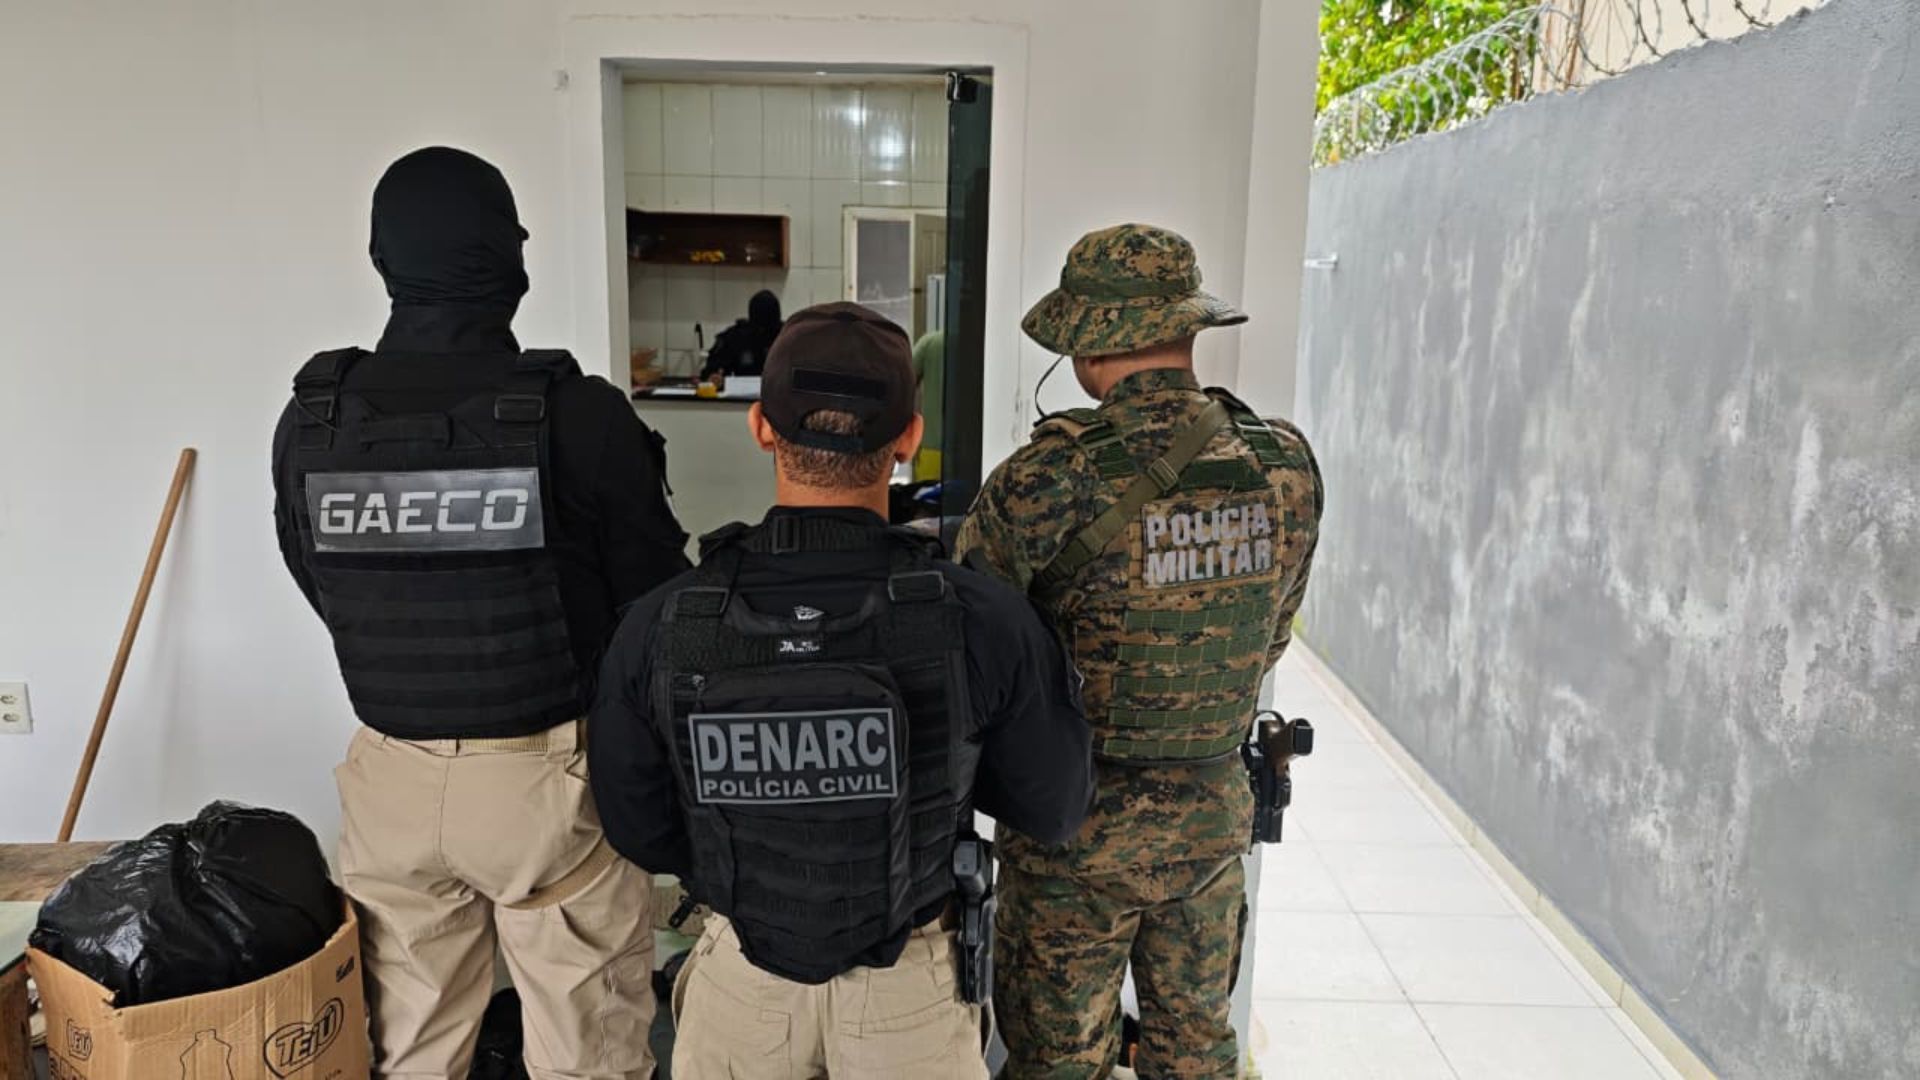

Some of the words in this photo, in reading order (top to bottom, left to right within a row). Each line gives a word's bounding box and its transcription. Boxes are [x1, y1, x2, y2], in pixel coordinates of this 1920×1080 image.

[319, 489, 529, 534] GAECO
[1146, 538, 1273, 588] MILITAR
[697, 716, 888, 773] DENARC
[702, 776, 811, 798] POLÍCIA
[818, 773, 890, 796] CIVIL
